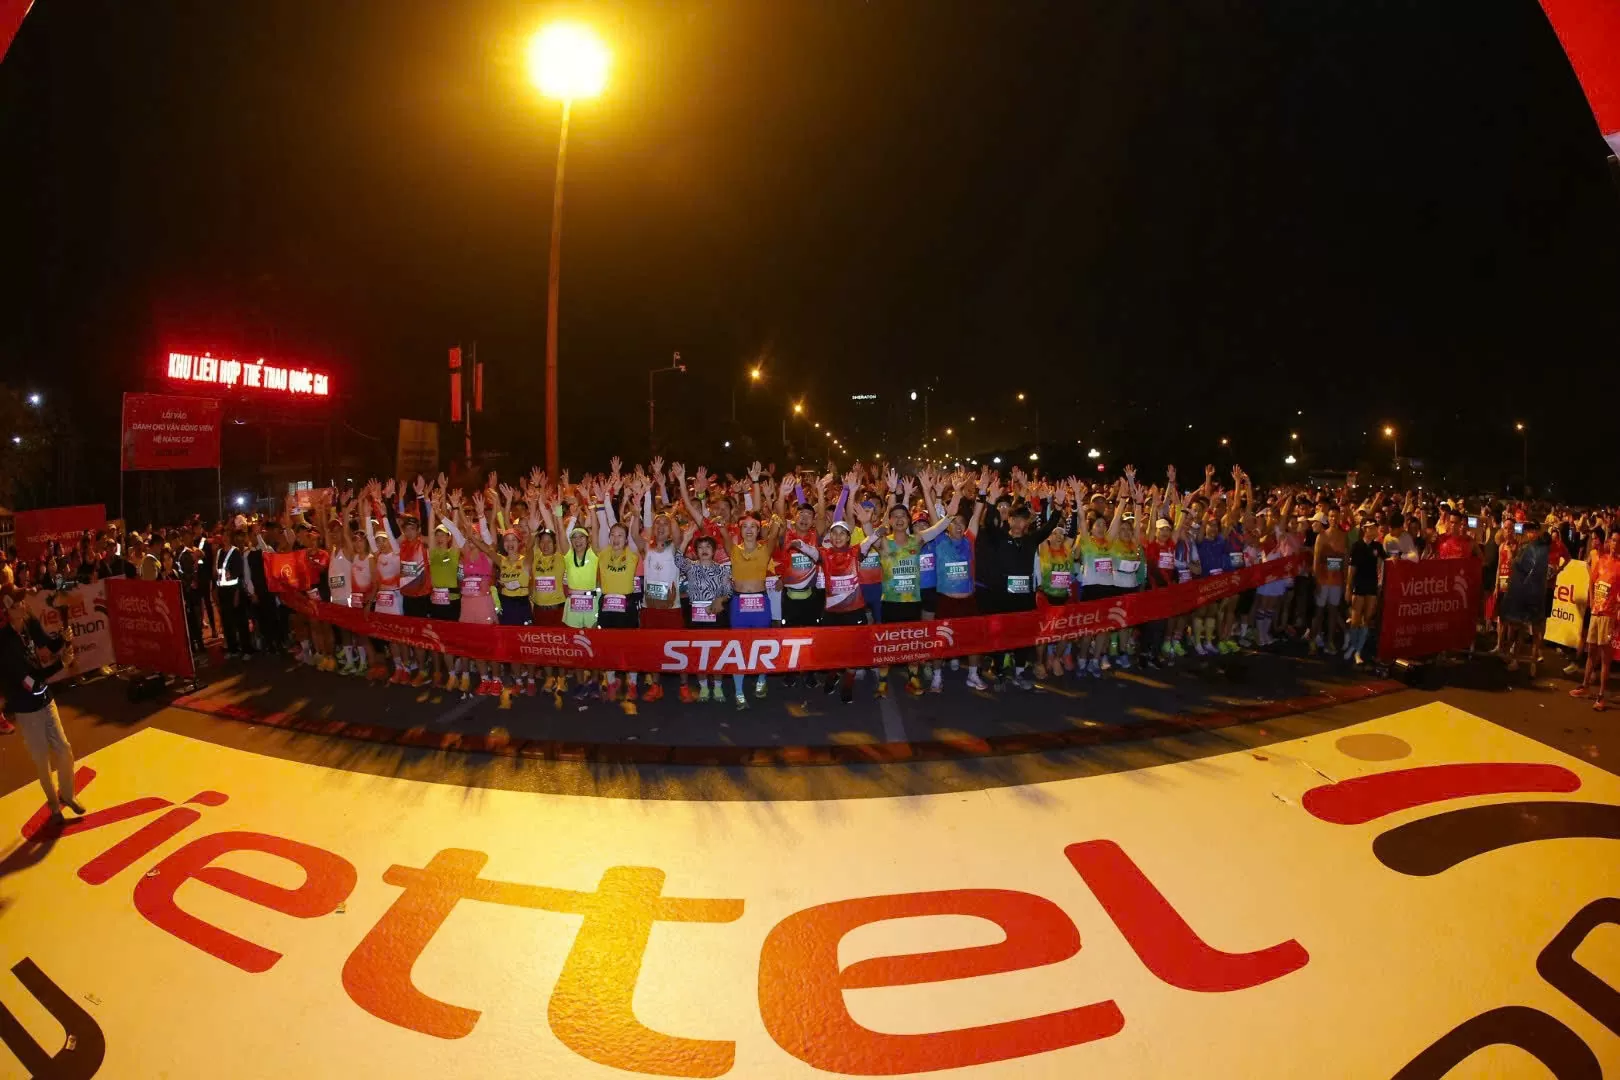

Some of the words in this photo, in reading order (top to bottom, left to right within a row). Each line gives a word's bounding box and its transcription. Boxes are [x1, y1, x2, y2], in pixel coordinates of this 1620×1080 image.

[168, 353, 192, 378] KHU
[193, 352, 218, 382] LIÊN
[1401, 574, 1449, 596] viettel
[1398, 596, 1460, 617] marathon
[1551, 607, 1575, 622] ction
[1038, 610, 1101, 633] viettel
[518, 632, 568, 645] viettel
[874, 627, 930, 642] viettel
[519, 644, 583, 658] marathon
[661, 639, 813, 670] START
[873, 638, 943, 654] marathon
[21, 765, 1310, 1078] viettel
